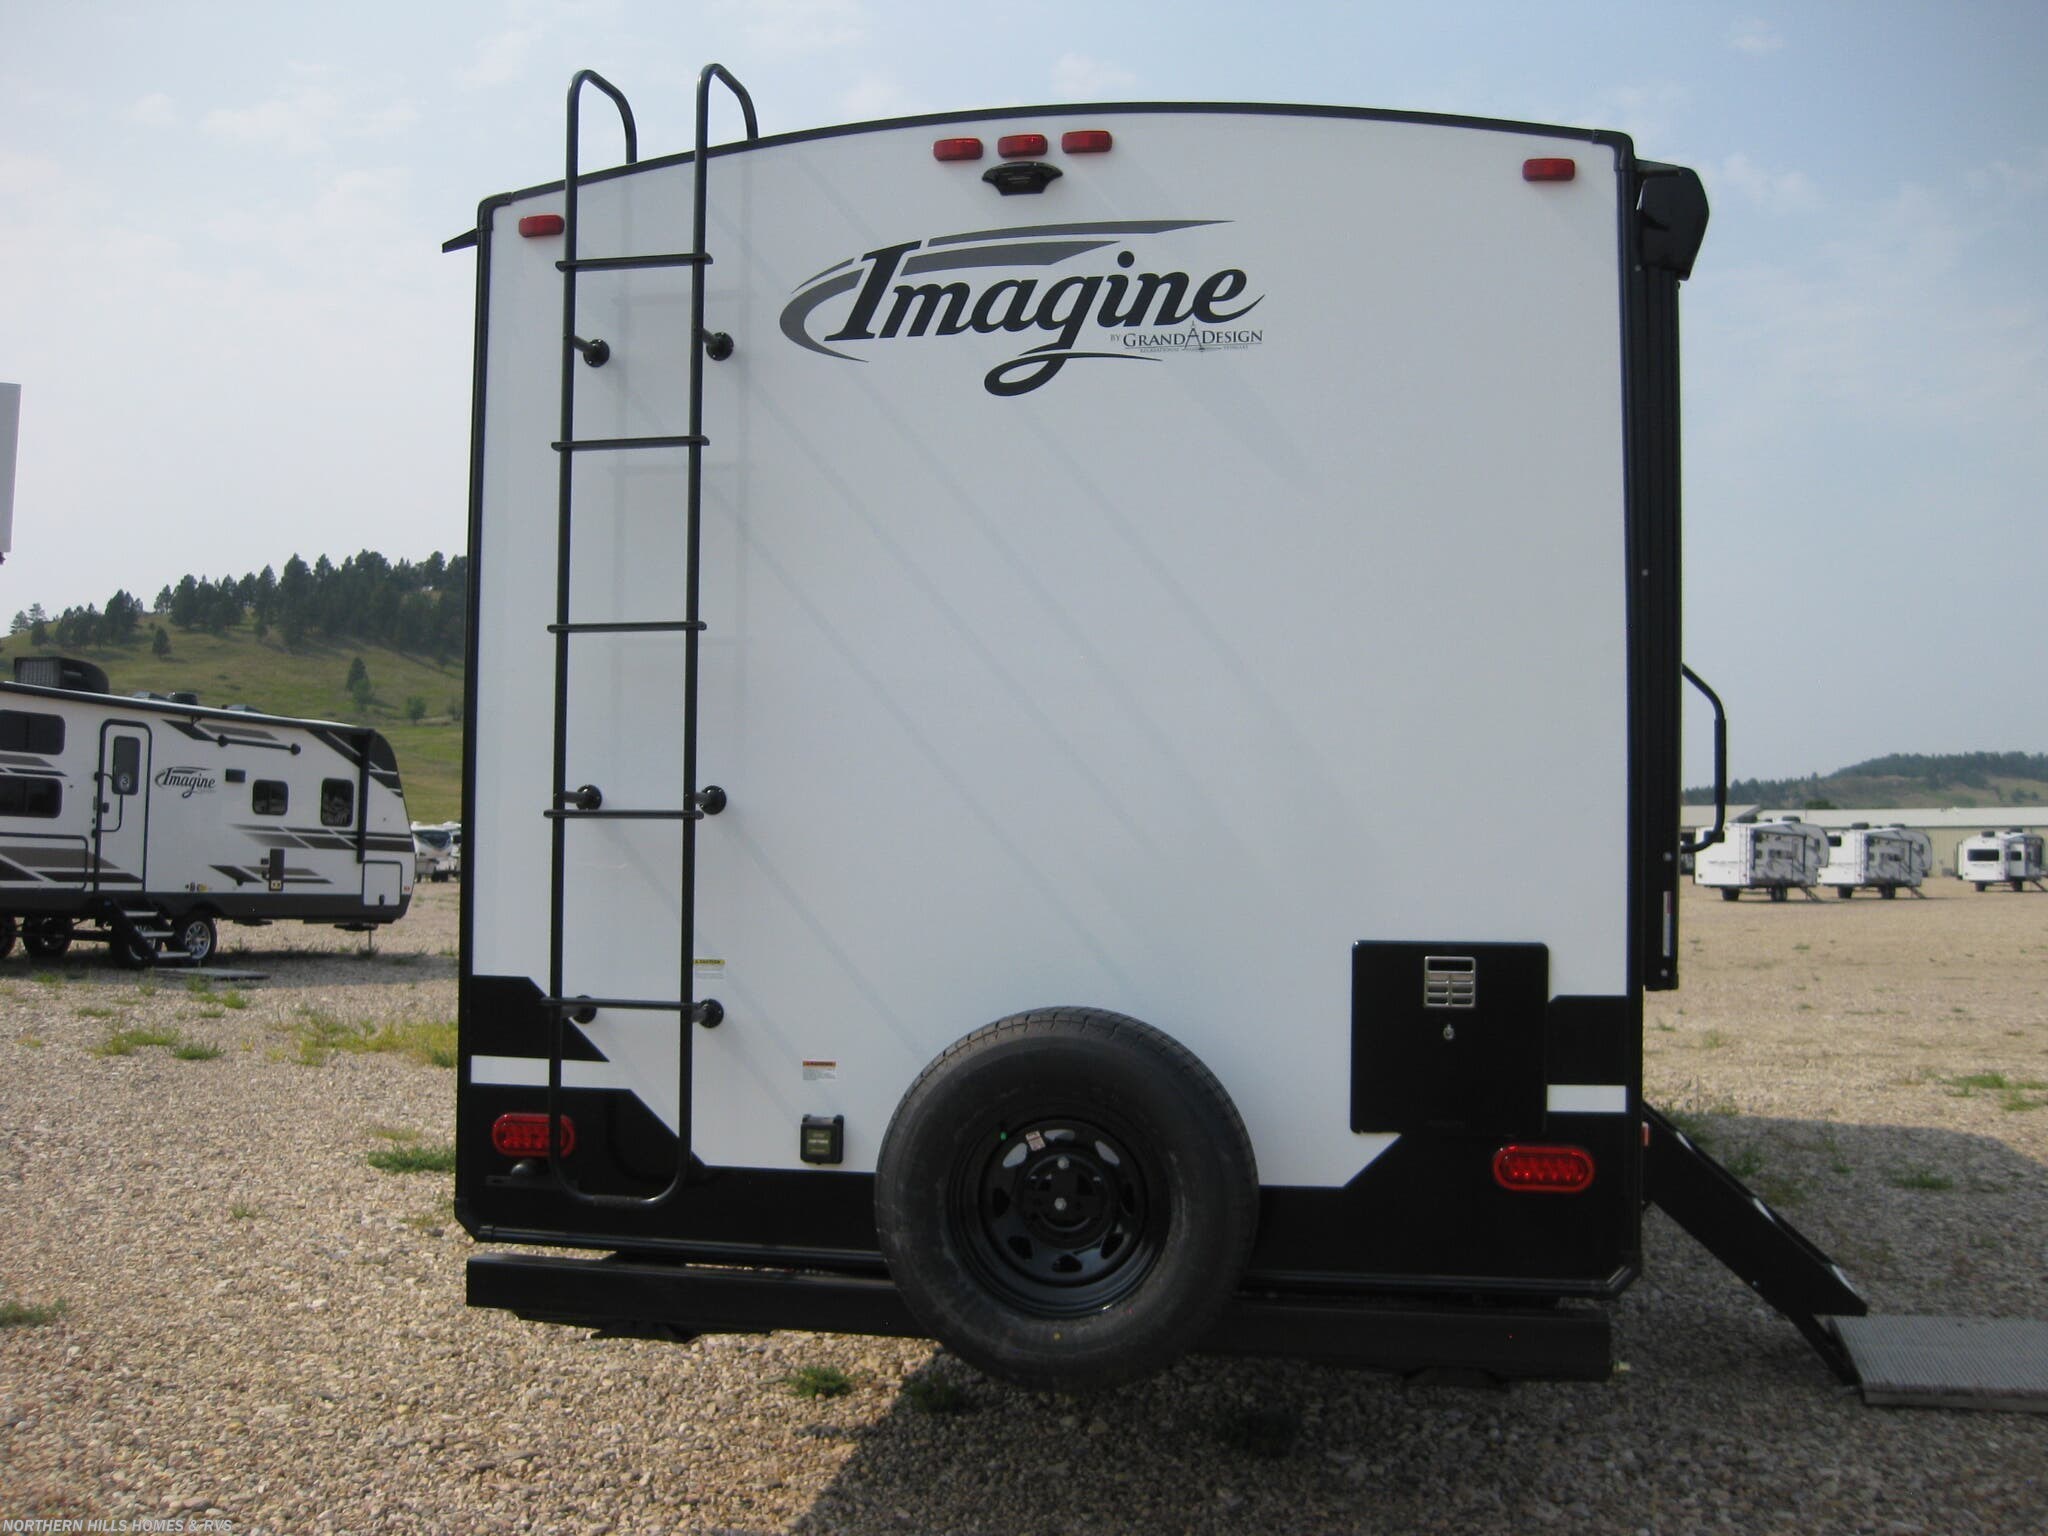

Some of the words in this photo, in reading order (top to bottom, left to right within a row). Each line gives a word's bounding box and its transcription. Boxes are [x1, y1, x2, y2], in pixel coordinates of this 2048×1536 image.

[824, 240, 1265, 396] Imagine
[1110, 334, 1120, 342] BY
[1123, 333, 1185, 347] GRAND
[1202, 329, 1263, 344] DESIGN
[162, 767, 216, 799] Imagine
